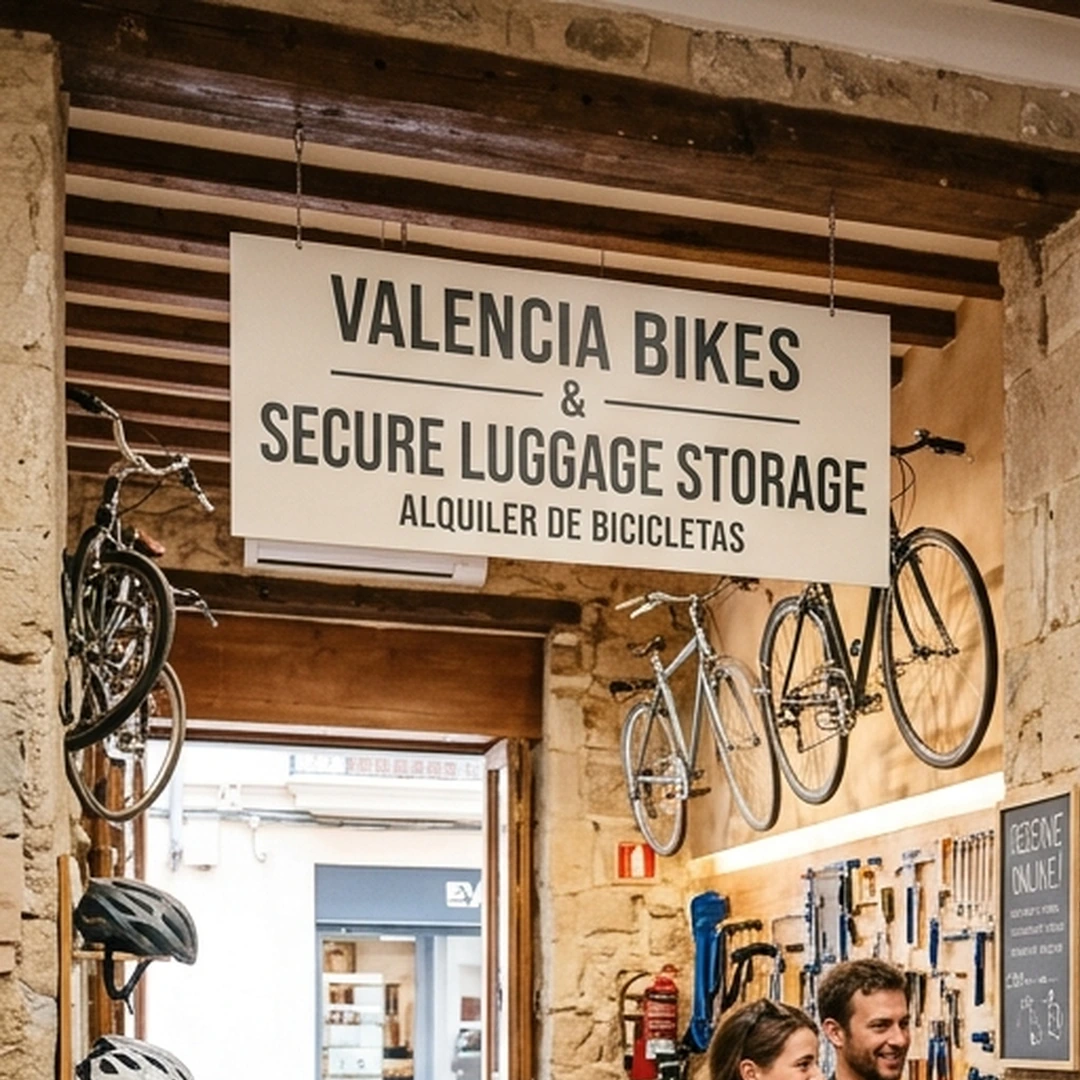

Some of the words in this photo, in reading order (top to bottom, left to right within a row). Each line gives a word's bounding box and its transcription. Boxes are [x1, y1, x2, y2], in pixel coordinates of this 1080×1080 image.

[330, 274, 611, 371] VALENCIA
[633, 310, 801, 391] BIKES
[560, 379, 586, 418] &
[259, 401, 445, 477] SECURE
[461, 421, 664, 497] LUGGAGE
[677, 443, 868, 515] STORAGE
[399, 493, 538, 537] ALQUILER
[548, 507, 581, 540] DE
[592, 510, 745, 553] BICICLETAS
